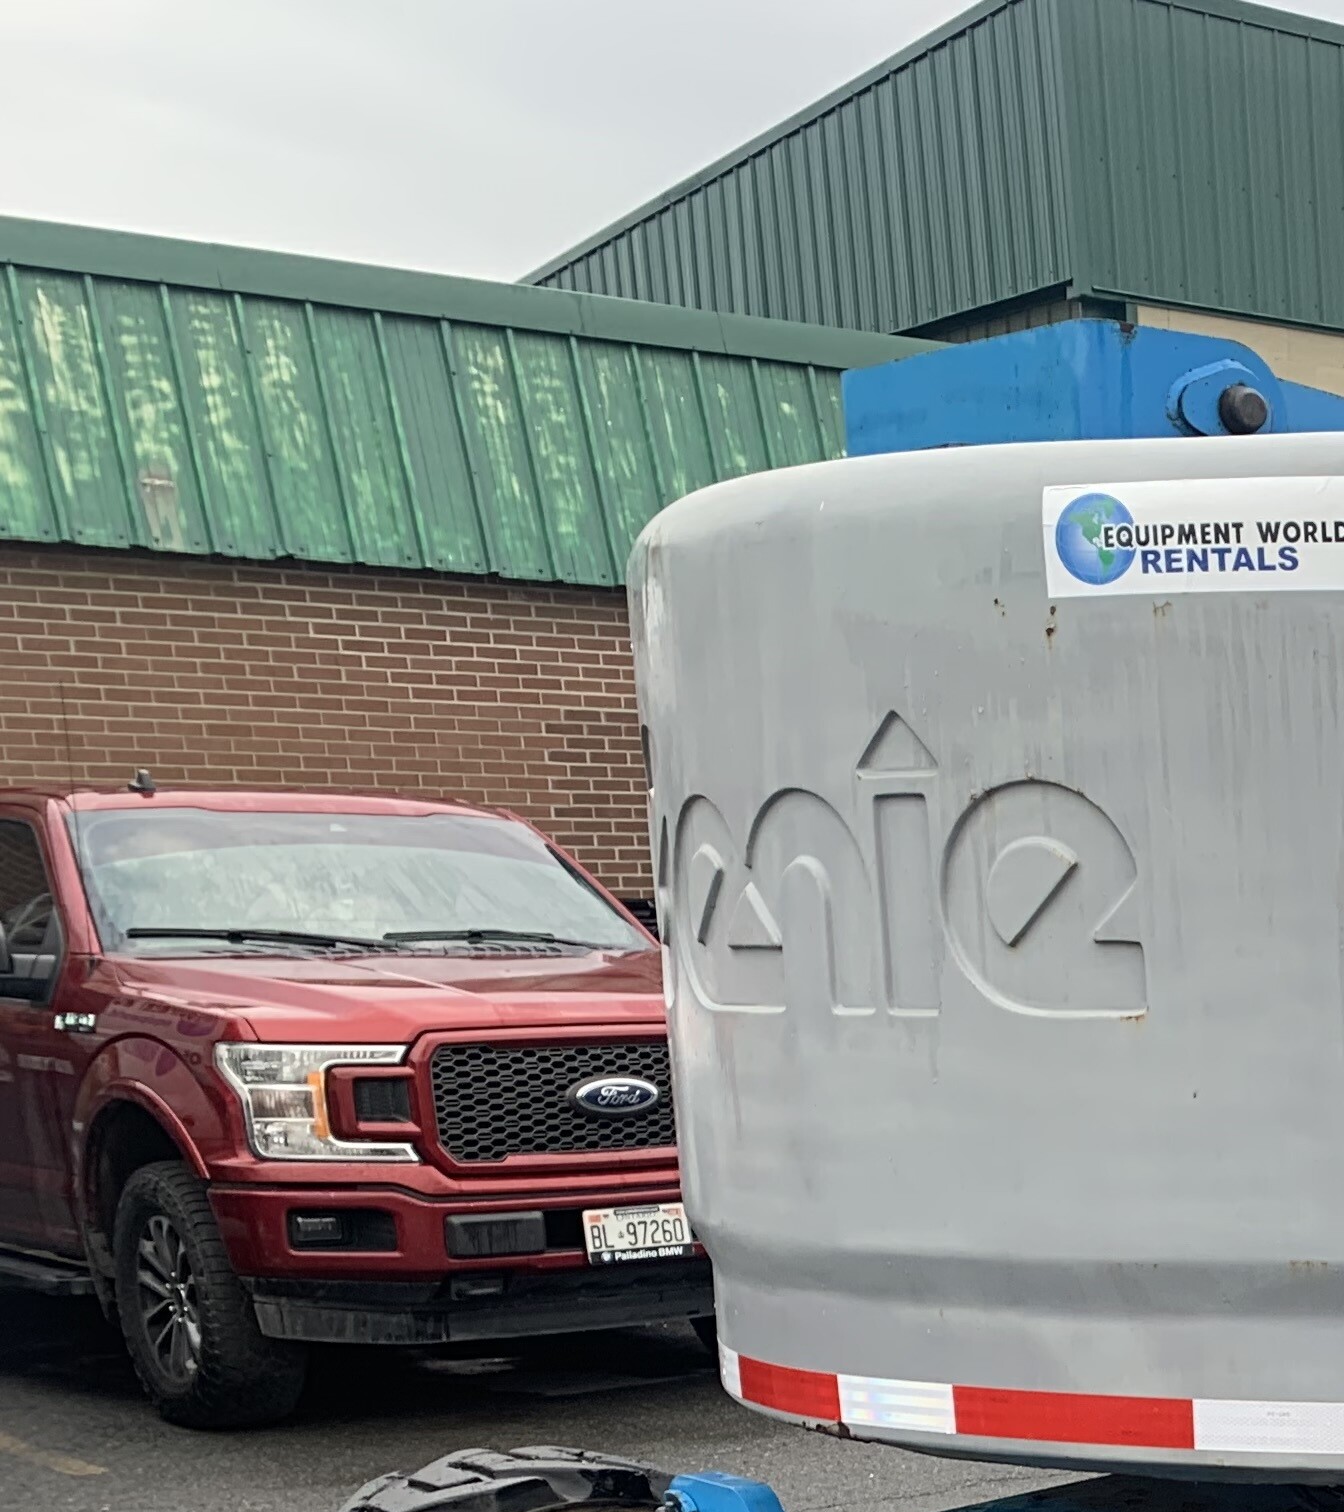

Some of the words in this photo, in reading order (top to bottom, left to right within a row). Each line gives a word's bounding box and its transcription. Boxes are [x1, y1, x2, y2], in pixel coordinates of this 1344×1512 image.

[1103, 521, 1244, 550] EQUIPMENT
[1140, 546, 1300, 574] RENTALS
[597, 1086, 641, 1106] Ford
[590, 1224, 614, 1250] BL
[626, 1218, 685, 1246] 97260
[614, 1249, 658, 1261] Palladino
[658, 1246, 684, 1257] BMW
